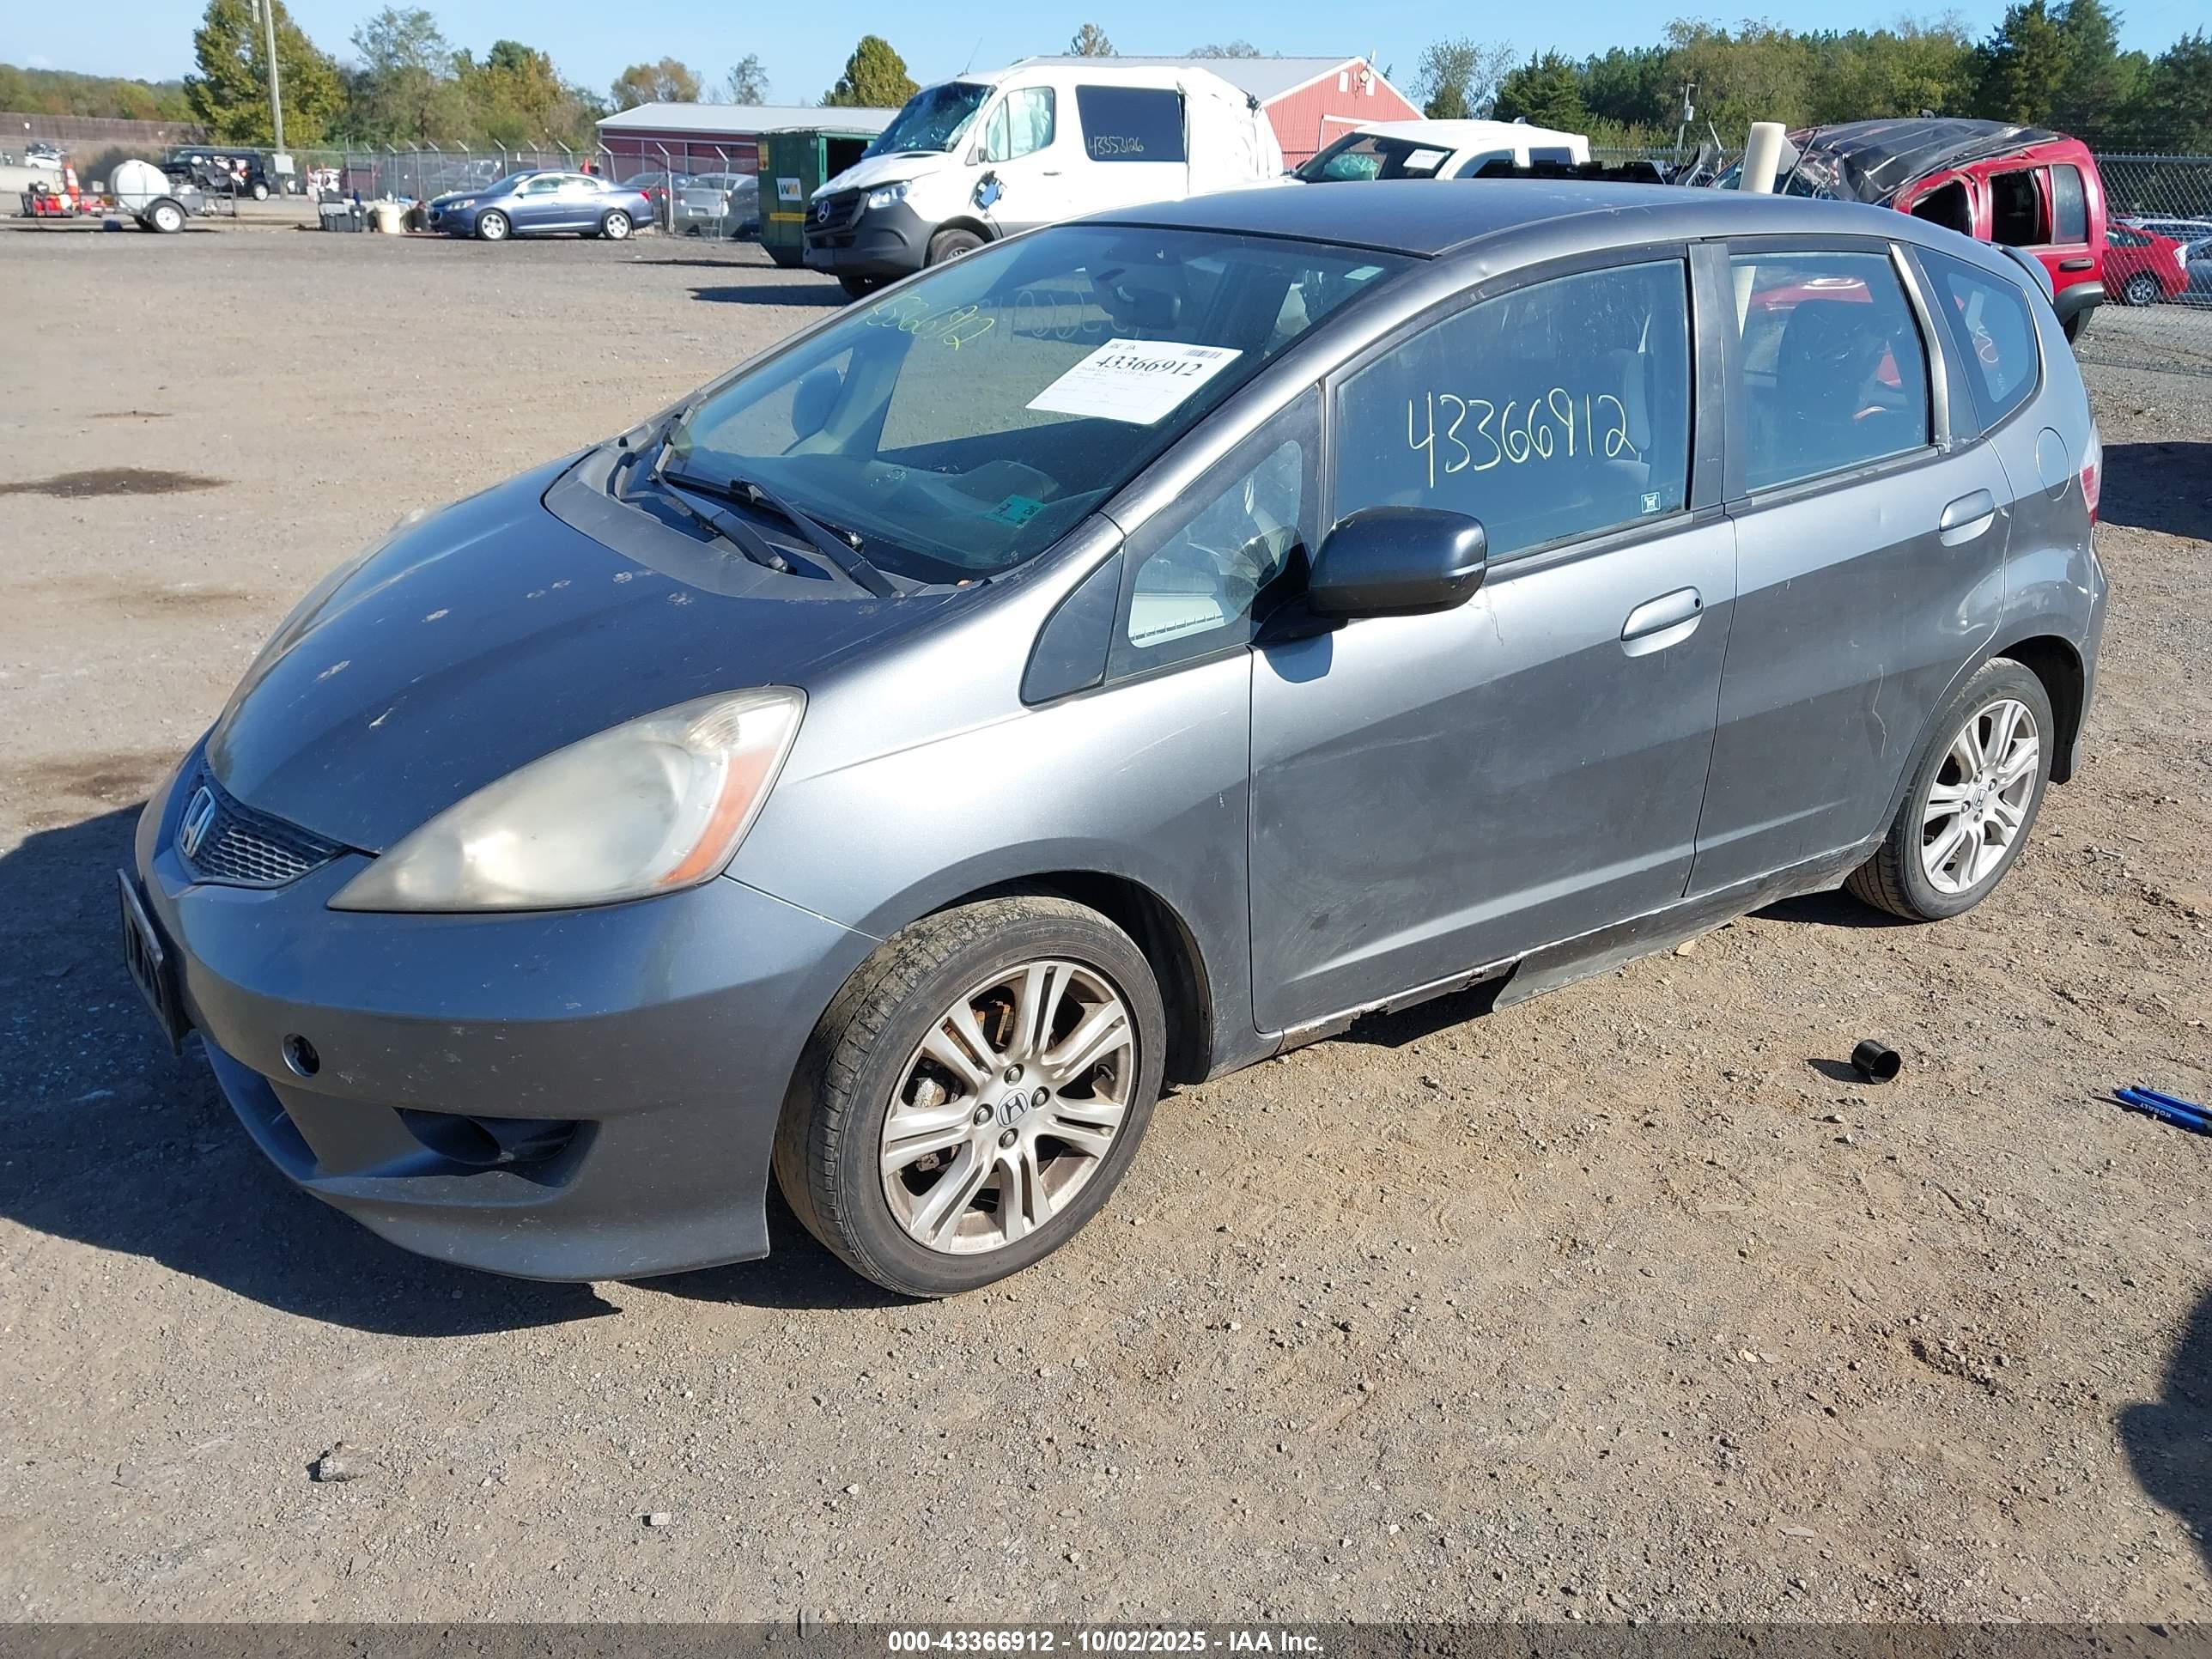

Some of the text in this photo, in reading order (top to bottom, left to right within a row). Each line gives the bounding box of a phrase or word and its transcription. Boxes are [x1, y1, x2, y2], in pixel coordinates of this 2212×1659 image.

[1096, 354, 1203, 376] 43366912
[1408, 386, 1637, 489] 43366912
[2139, 1102, 2172, 1118] KOBALT
